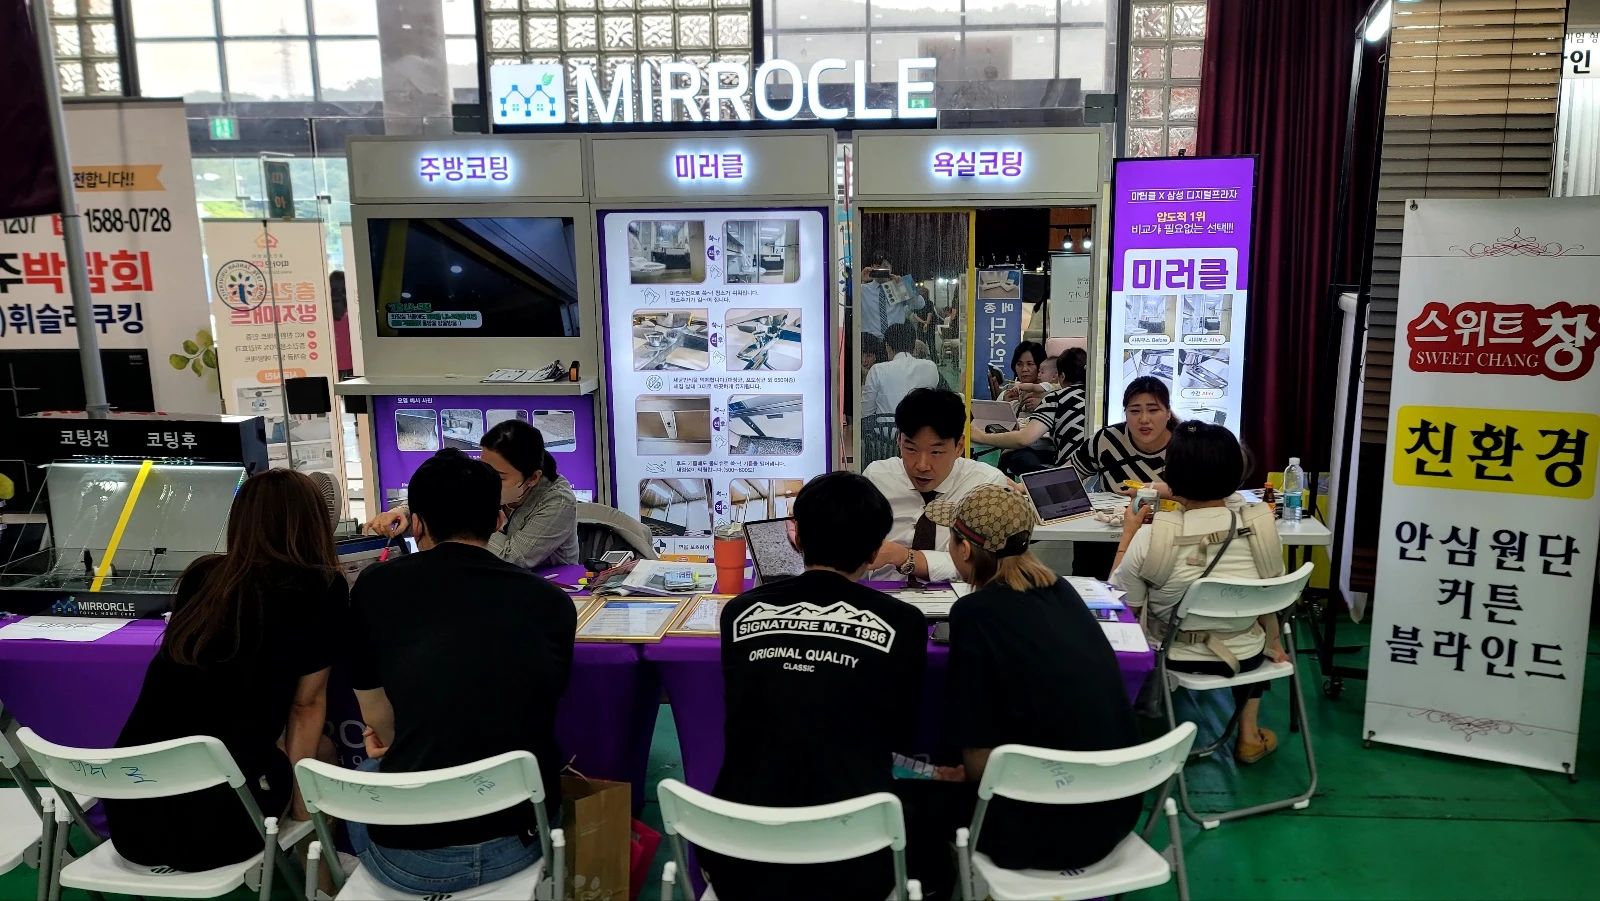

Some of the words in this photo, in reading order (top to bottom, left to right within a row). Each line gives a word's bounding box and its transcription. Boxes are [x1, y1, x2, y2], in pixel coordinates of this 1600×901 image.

[1563, 50, 1591, 75] 인
[576, 57, 938, 124] MIRROCLE
[420, 156, 509, 182] 주방코팅
[675, 153, 744, 180] 미러클
[933, 151, 1024, 178] 욕실코팅
[1131, 192, 1156, 202] 미러클
[1158, 192, 1165, 200] X
[1167, 191, 1184, 201] 삼성
[1187, 190, 1238, 201] 디지털프라자
[84, 207, 172, 233] 1588-0728
[1131, 224, 1162, 235] 비교가
[1164, 224, 1203, 235] 필요없는
[1156, 211, 1187, 223] 압도적
[1190, 211, 1206, 223] 1위
[1132, 258, 1229, 291] 미러클
[1414, 310, 1524, 347] 스위트
[1532, 310, 1597, 373] 창
[1416, 351, 1474, 366] SWEET
[1477, 352, 1539, 368] CHANG
[60, 430, 109, 447] 코팅전
[147, 431, 198, 449] 코팅후
[1404, 418, 1590, 488] 친환경
[1395, 521, 1581, 577] 안심원단
[78, 601, 135, 612] MIRRORCLE
[1437, 578, 1524, 626] 커튼
[739, 619, 819, 635] SIGNATURE
[823, 621, 851, 635] M.T
[854, 627, 887, 644] 1986
[749, 647, 802, 662] ORIGINAL
[805, 649, 859, 668] QUALITY
[1385, 624, 1567, 680] 블라인드
[783, 662, 815, 673] CLASSIC
